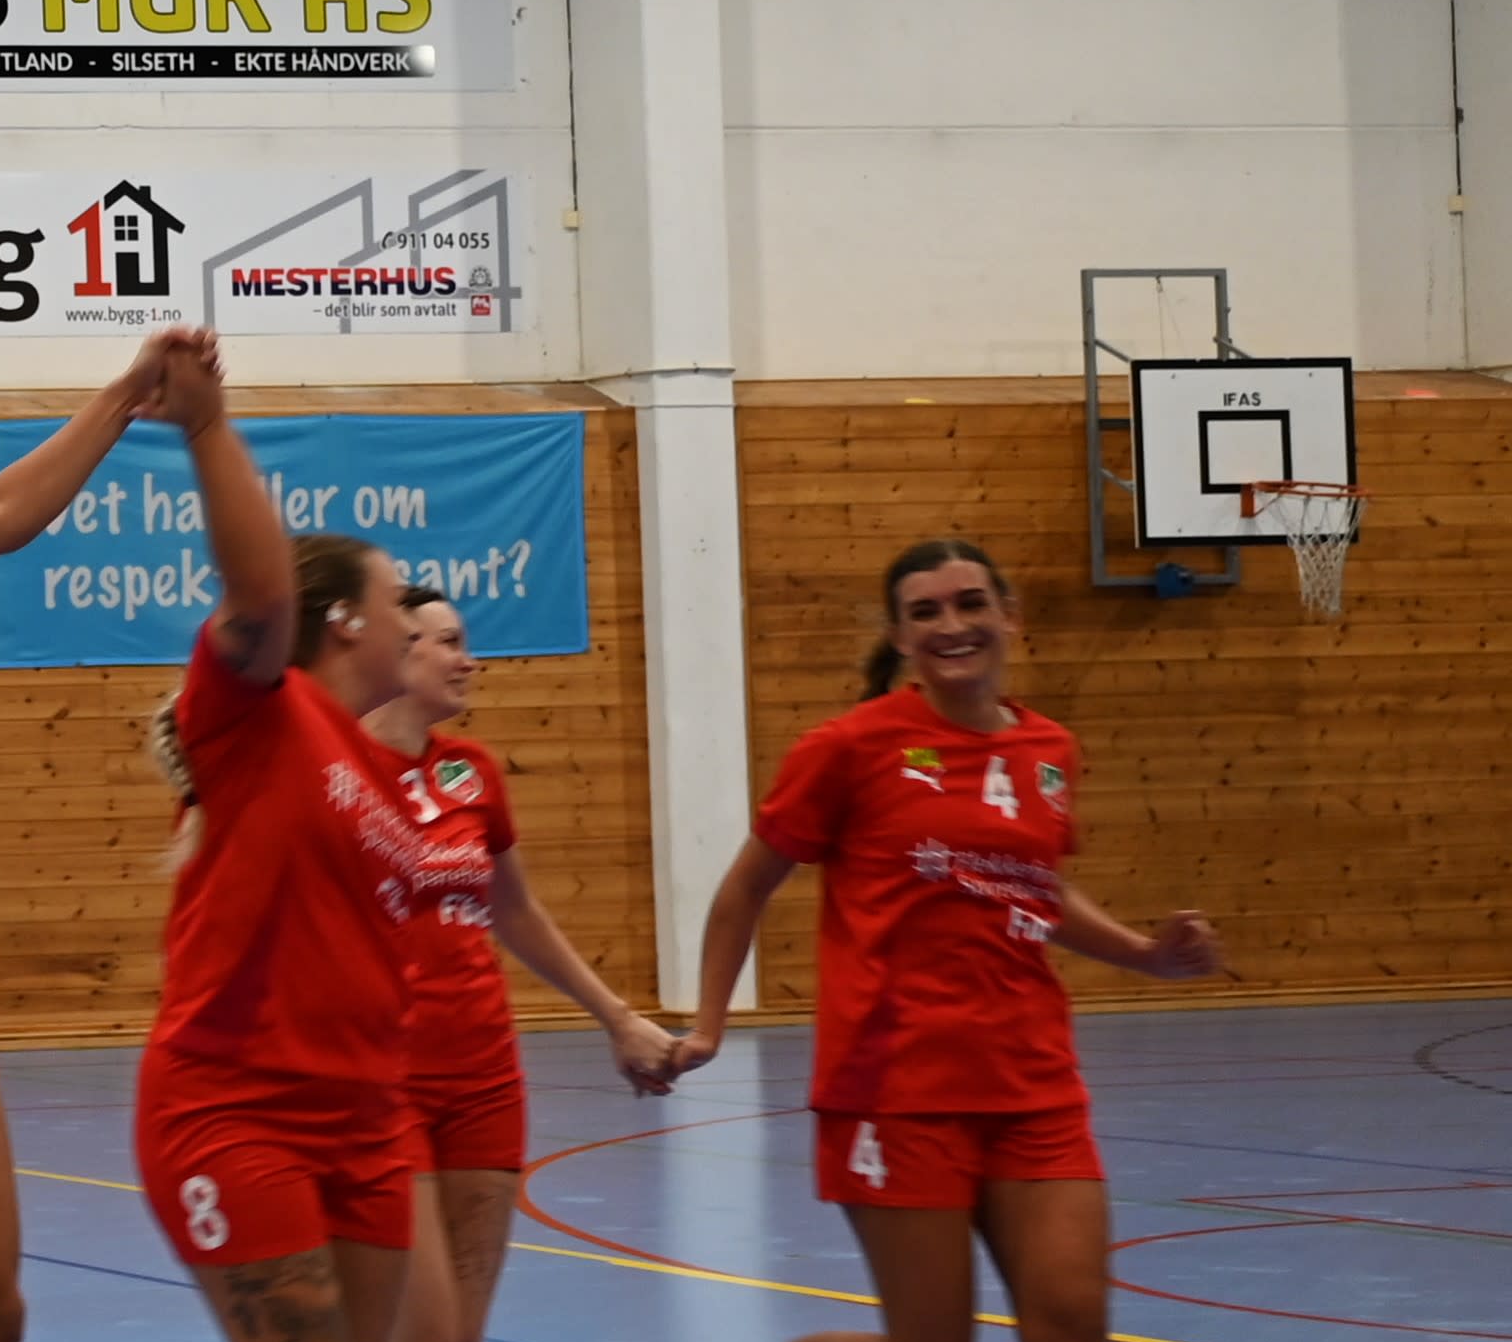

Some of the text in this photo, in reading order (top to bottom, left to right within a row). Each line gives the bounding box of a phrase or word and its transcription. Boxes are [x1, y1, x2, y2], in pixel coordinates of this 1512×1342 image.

[111, 51, 195, 72] SILSETH
[234, 51, 288, 72] EKTE
[291, 46, 410, 72] HÅNDVERK
[397, 232, 490, 249] 911 04 055
[232, 267, 457, 296] MESTERHUS
[65, 306, 182, 325] www.bygg-1.no
[325, 304, 457, 317] det blir som avtalt
[354, 485, 427, 529] om
[982, 755, 1020, 819] 4
[847, 1121, 888, 1188] 4
[180, 1174, 230, 1251] 8
